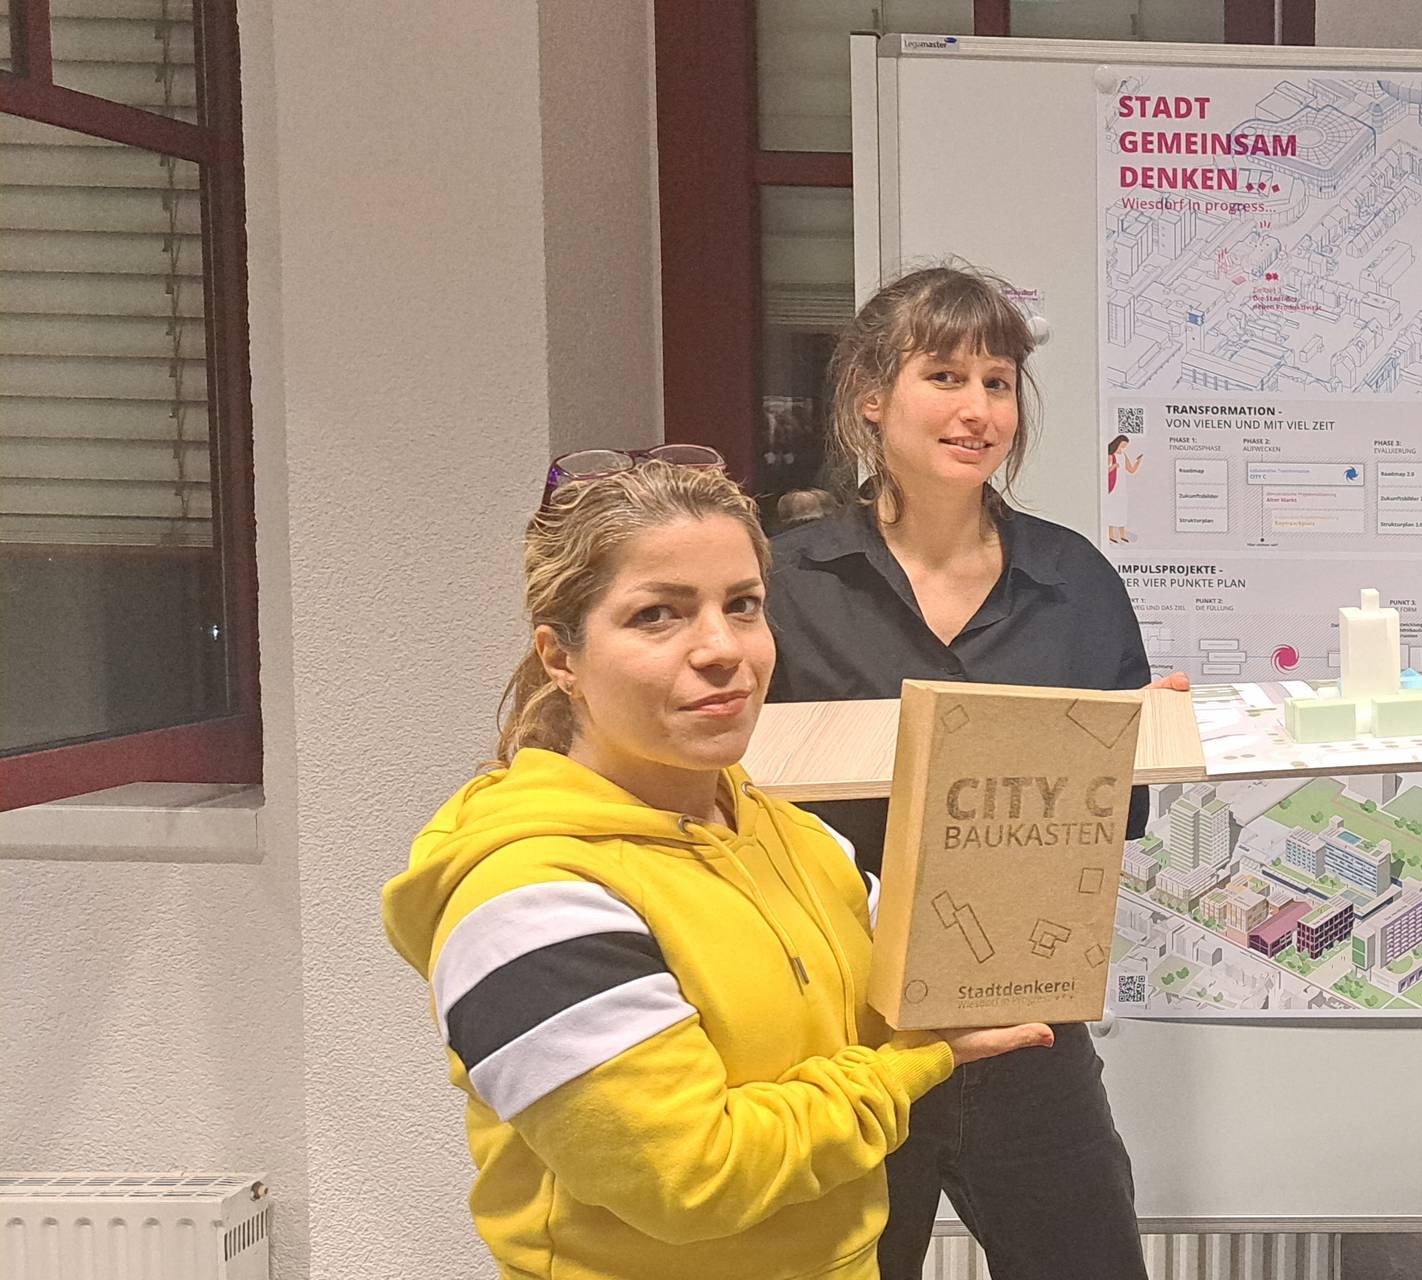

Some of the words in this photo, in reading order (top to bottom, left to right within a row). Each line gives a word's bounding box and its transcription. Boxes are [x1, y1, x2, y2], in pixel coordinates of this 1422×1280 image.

[1119, 96, 1210, 119] STADT
[1119, 132, 1297, 156] GEMEINSAM
[1120, 167, 1238, 191] DENKEN
[1122, 198, 1184, 210] Wiesdorf
[1205, 202, 1277, 214] progress...
[1165, 405, 1276, 416] TRANSFORMATION
[1165, 418, 1191, 428] VON
[1194, 419, 1232, 429] VIELEN
[1235, 420, 1261, 430] UND
[1263, 420, 1284, 431] MIT
[1286, 420, 1310, 431] VIEL
[1312, 421, 1335, 431] ZEIT
[1118, 565, 1216, 576] IMPULSPROJEKTE
[1143, 578, 1167, 588] VIER
[1170, 578, 1214, 588] PUNKTE
[1217, 579, 1246, 588] PLAN
[946, 777, 1068, 821] CITY
[1085, 776, 1117, 818] C
[944, 822, 1116, 850] BAUKASTEN
[958, 977, 1075, 999] Stadtdenkerei
